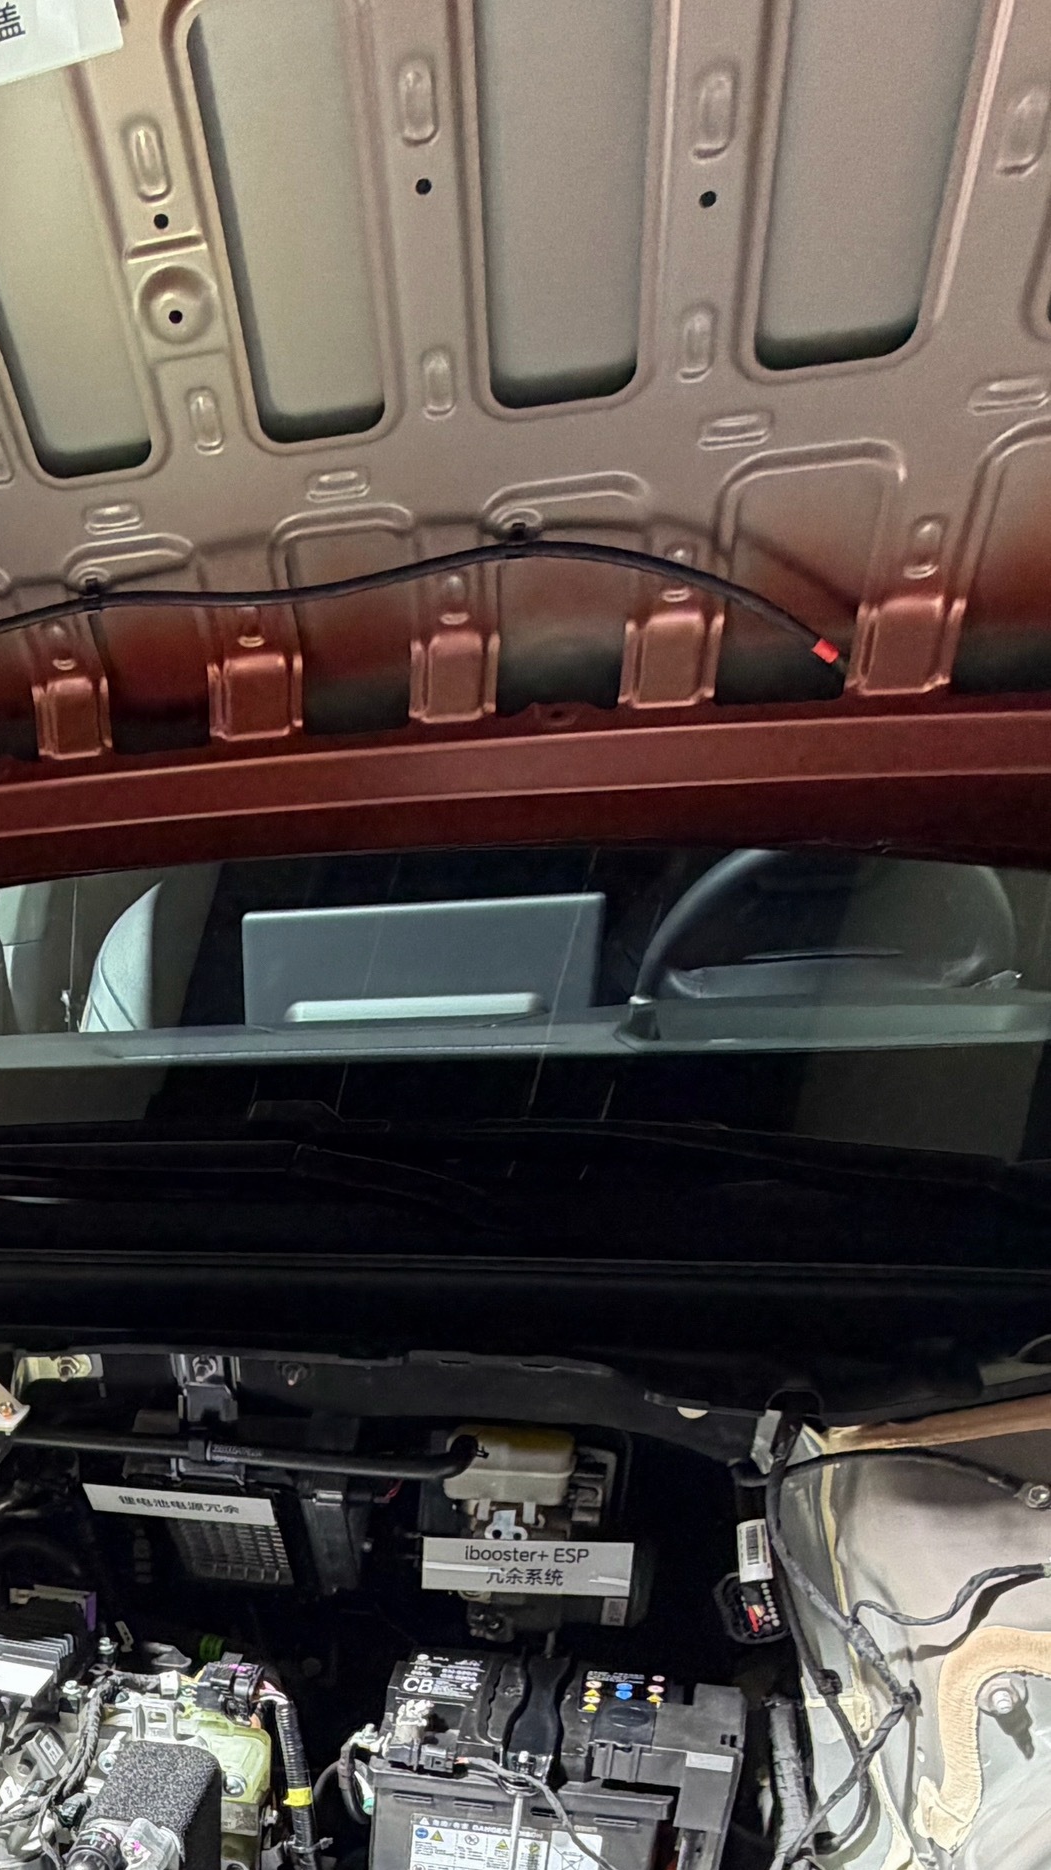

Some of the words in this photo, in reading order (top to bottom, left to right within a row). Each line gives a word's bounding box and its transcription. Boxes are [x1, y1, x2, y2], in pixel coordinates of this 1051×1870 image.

[118, 1495, 240, 1514] 锂电池电源冗余
[464, 1545, 548, 1562] ibooster+
[553, 1547, 590, 1563] ESP
[486, 1567, 564, 1586] 冗余系统
[403, 1677, 434, 1694] CB
